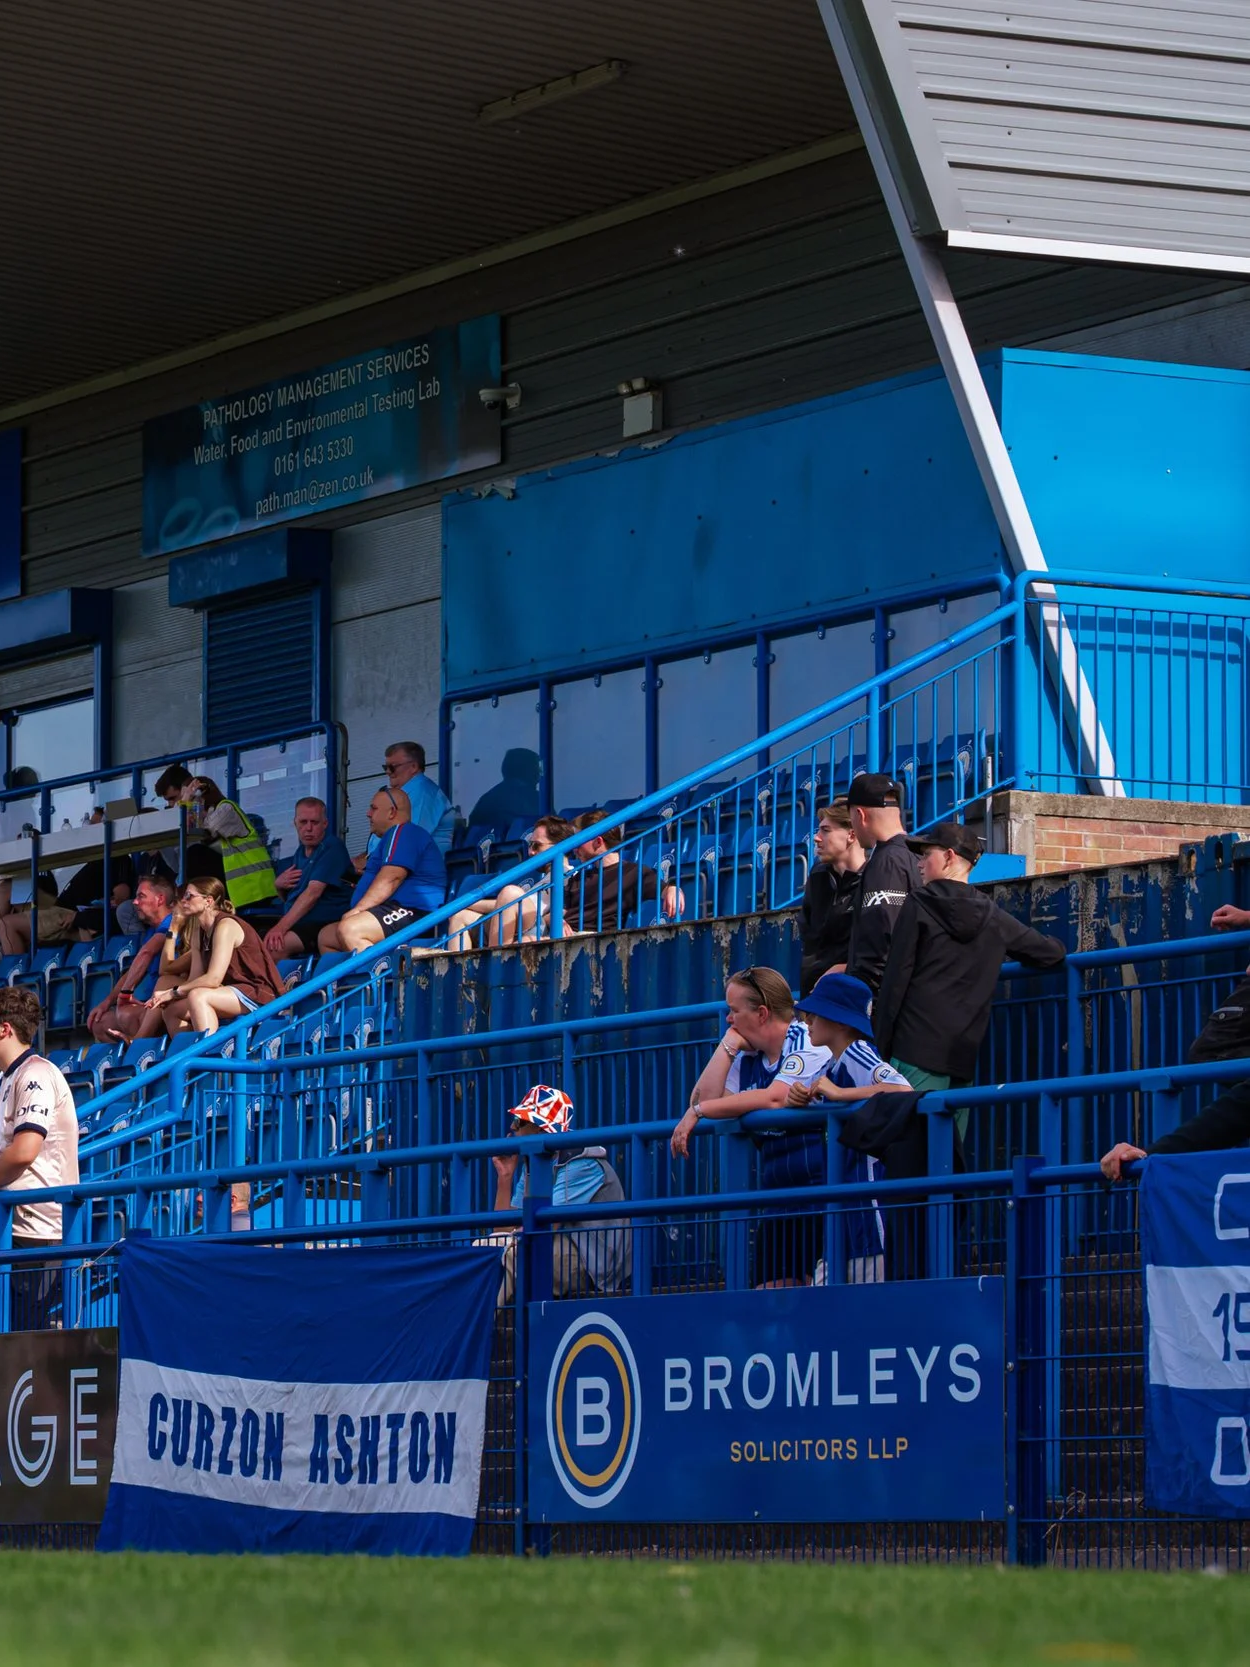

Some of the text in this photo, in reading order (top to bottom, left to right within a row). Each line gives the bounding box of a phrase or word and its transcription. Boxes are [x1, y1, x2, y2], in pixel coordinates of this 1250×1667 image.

[203, 343, 430, 430] PATHOLOGY MANAGEMENT SERVICES
[230, 428, 258, 456] Food
[261, 422, 283, 445] and
[286, 399, 368, 440] Environmental
[371, 385, 415, 413] Testing
[418, 376, 440, 401] Lab
[274, 435, 354, 477] 0161 643 5330
[255, 465, 374, 521] path.man@zen.co.uk
[575, 1376, 612, 1447] B
[664, 1343, 982, 1412] BROMLEYS
[148, 1391, 457, 1485] CURZON ASHTON
[729, 1436, 909, 1463] SOLICITORS LLP
